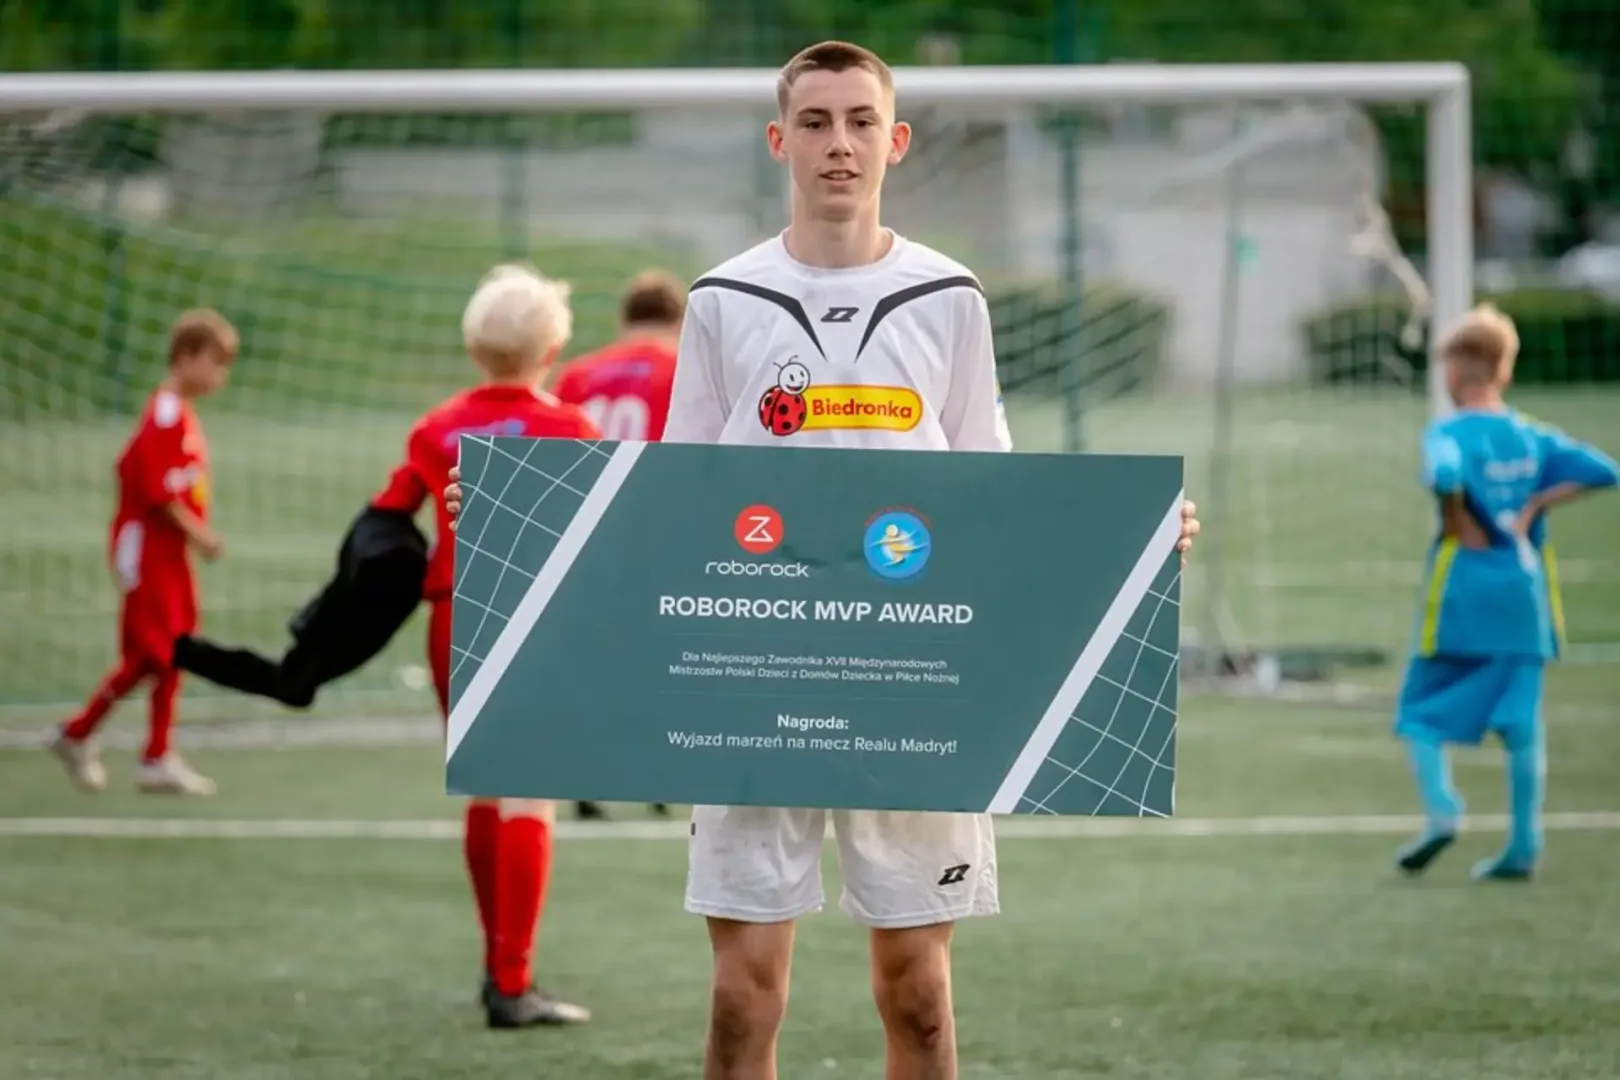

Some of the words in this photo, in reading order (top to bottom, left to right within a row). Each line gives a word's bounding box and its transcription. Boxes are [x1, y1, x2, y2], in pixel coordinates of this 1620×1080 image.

[811, 398, 913, 419] Biedronka
[705, 560, 809, 577] roborock
[659, 595, 807, 620] ROBOROCK
[814, 601, 872, 621] MVP
[878, 603, 973, 624] AWARD
[682, 651, 700, 661] Dla
[702, 652, 765, 666] Najlepszego
[767, 654, 823, 665] Zawodnika
[849, 657, 947, 670] Międzynarodowych
[669, 665, 723, 676] Mistrzostw
[725, 666, 756, 677] Polski
[758, 667, 790, 678] Dzieci
[791, 670, 798, 679] z
[800, 668, 840, 680] Domów
[841, 670, 882, 682] Dziecka
[884, 673, 894, 682] w
[896, 671, 920, 683] Piłce
[923, 672, 960, 685] Nożnej
[777, 714, 850, 731] Nagroda:
[667, 731, 722, 749] Wyjazd
[726, 733, 783, 748] marzeń
[787, 737, 806, 749] na
[810, 738, 850, 750] mecz
[854, 737, 897, 751] Realu
[901, 738, 957, 756] Madryt!
